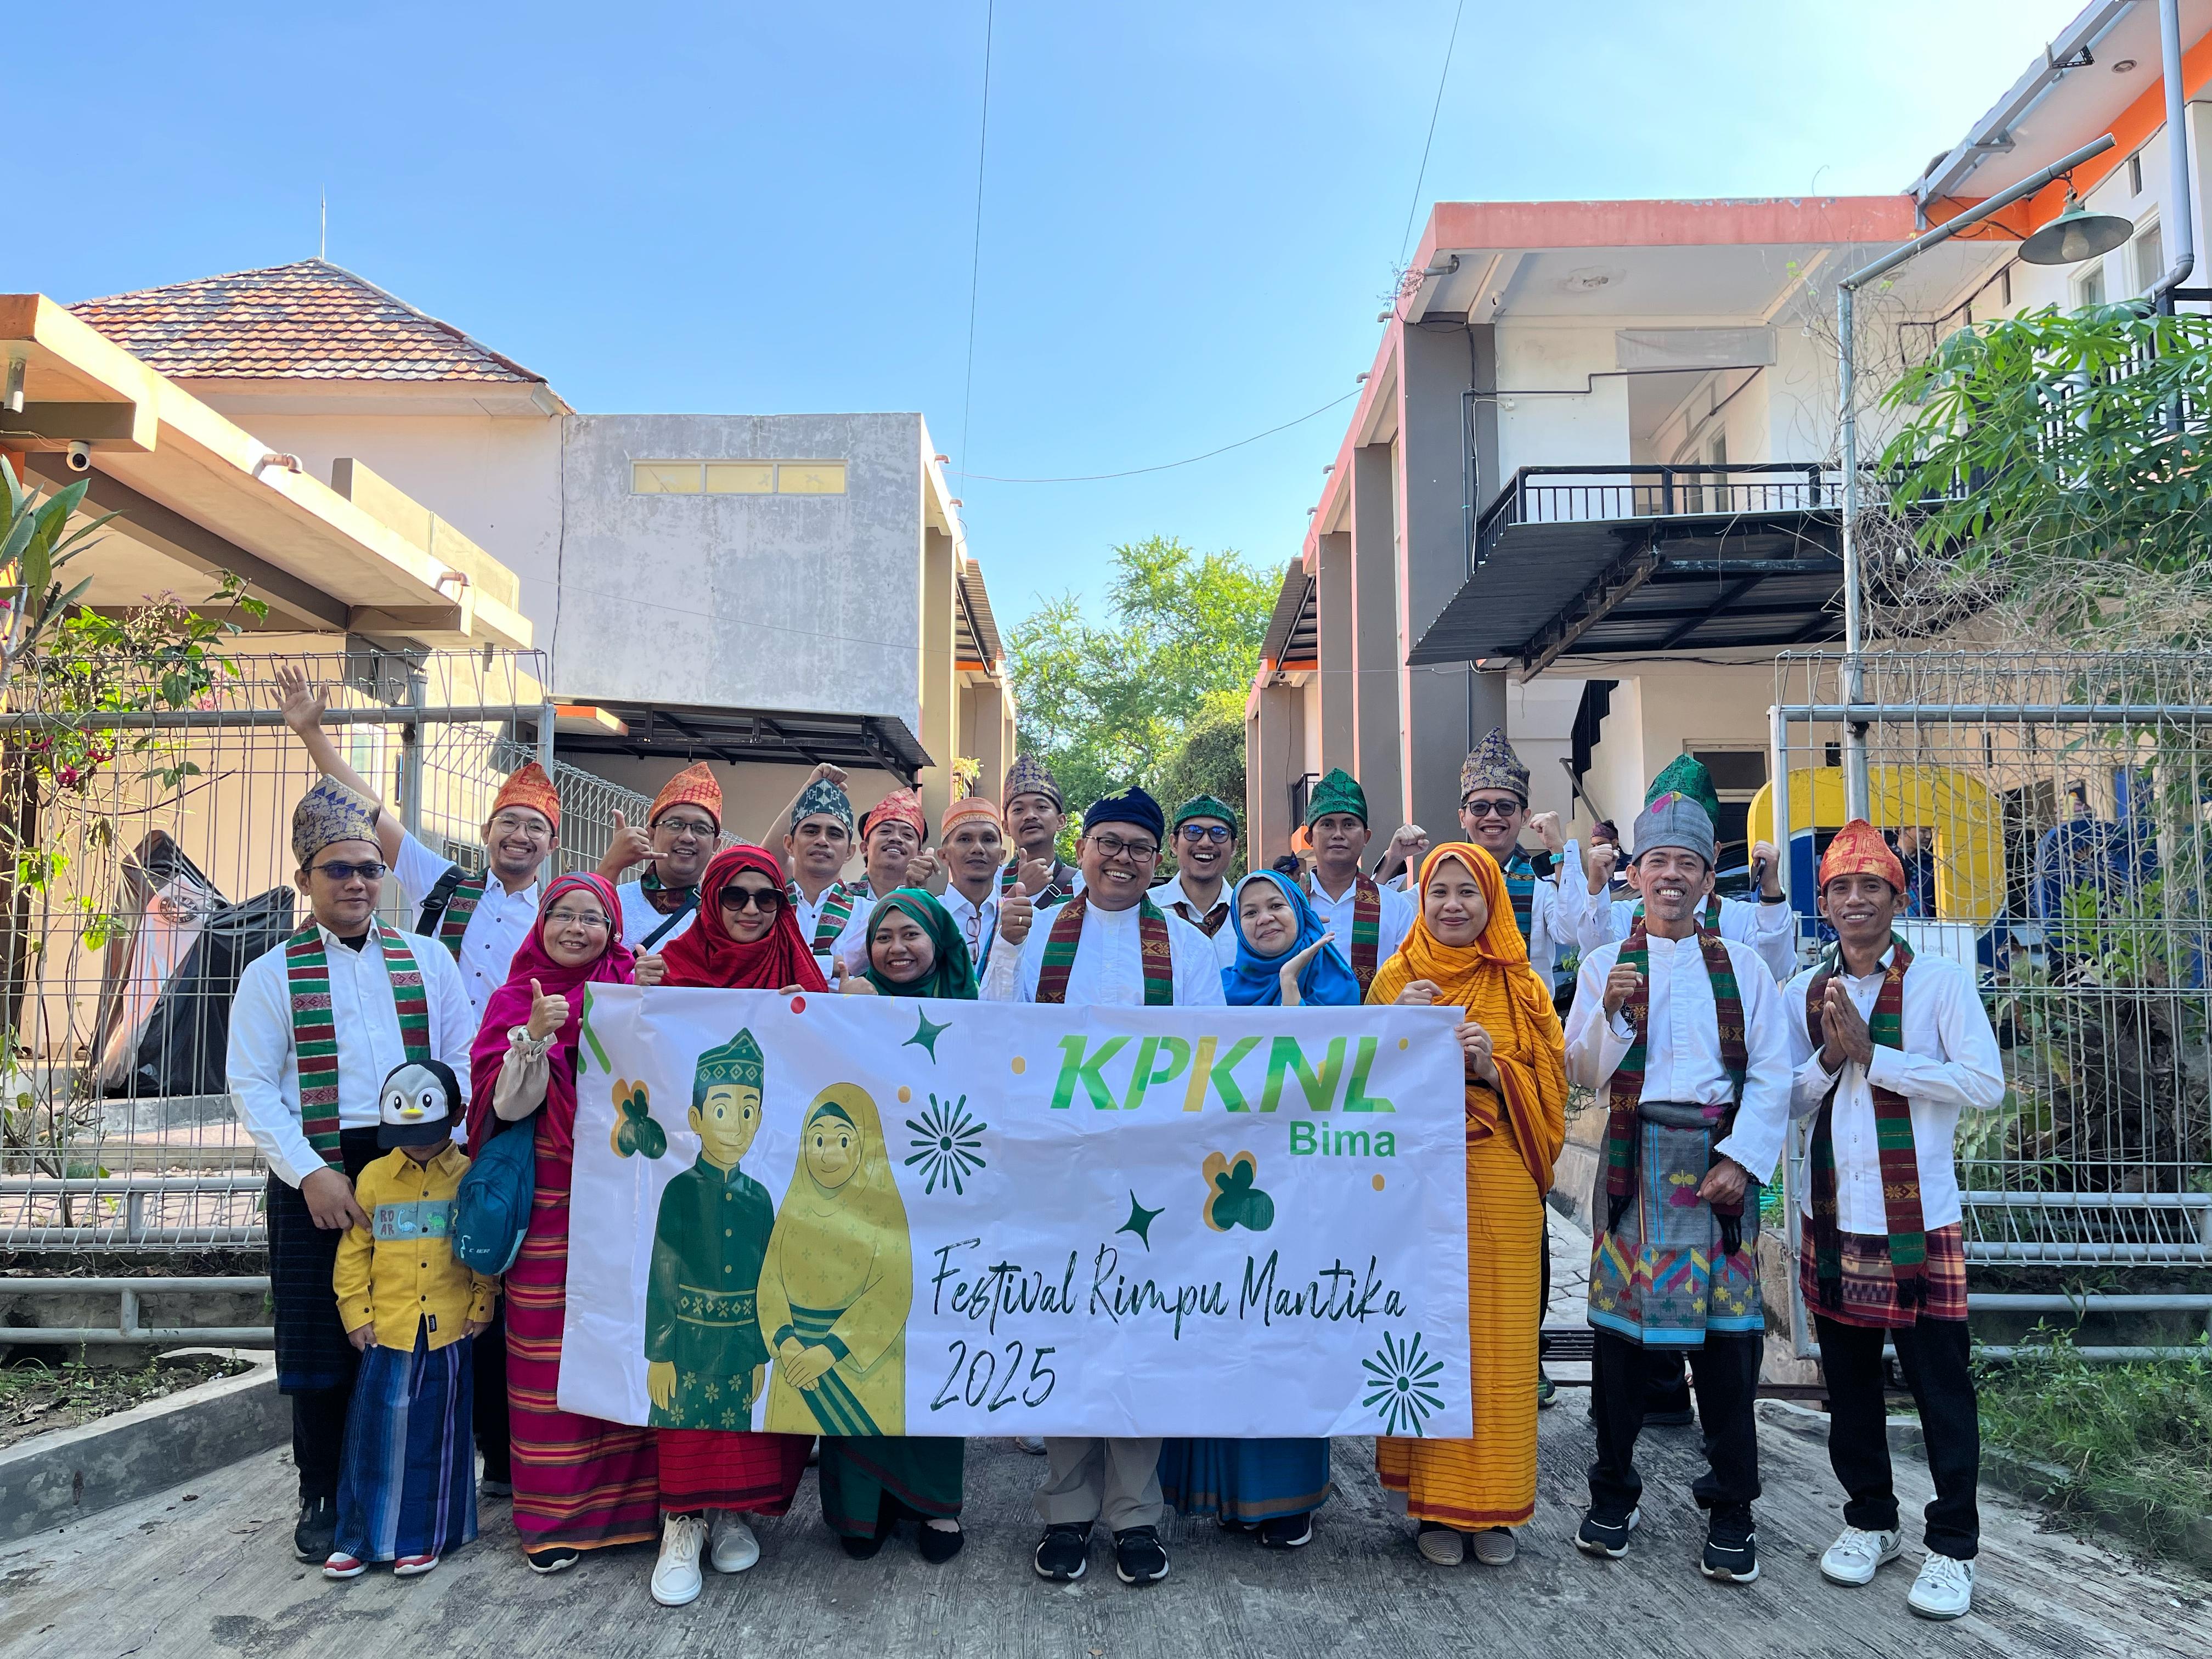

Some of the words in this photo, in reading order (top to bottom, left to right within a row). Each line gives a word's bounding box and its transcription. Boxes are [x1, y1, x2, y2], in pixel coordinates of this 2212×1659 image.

[1051, 1035, 1396, 1113] KPKNL
[1290, 1120, 1396, 1157] Bima
[381, 1223, 394, 1235] AR
[932, 1238, 1077, 1336] Festival
[1090, 1243, 1229, 1341] Rimpu
[1239, 1249, 1407, 1327] Mantika
[930, 1340, 1056, 1413] 2025
